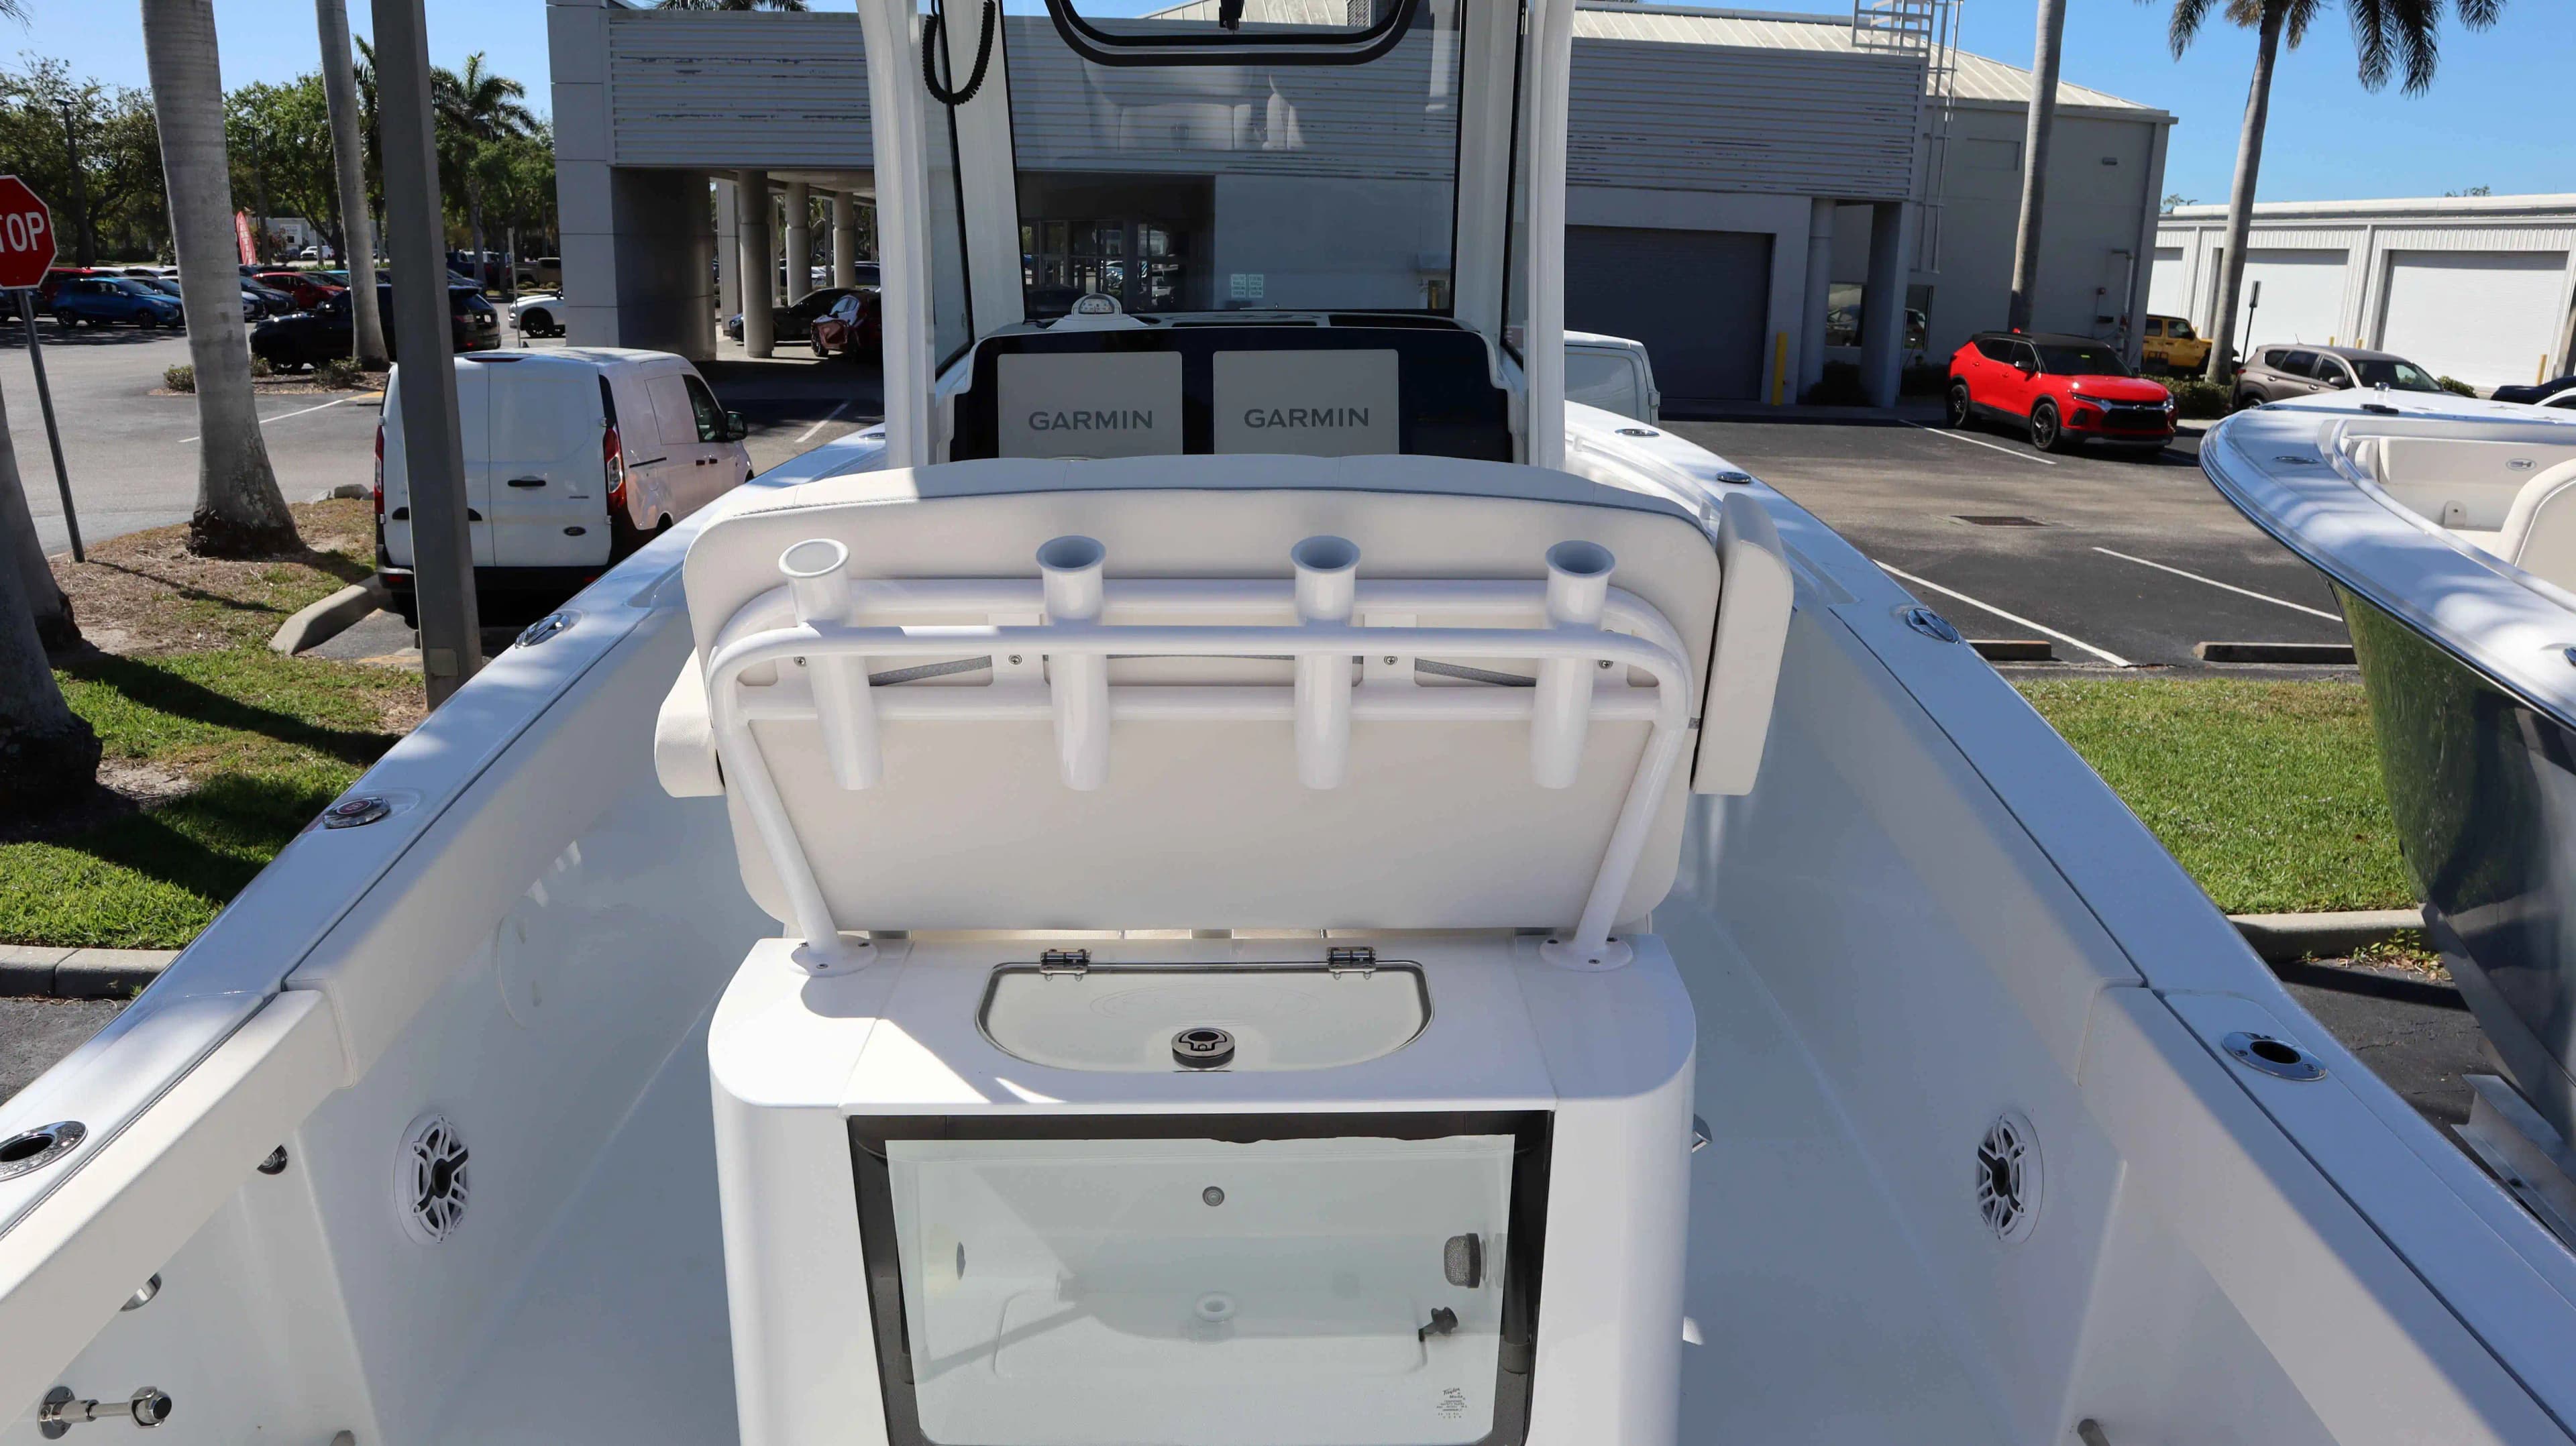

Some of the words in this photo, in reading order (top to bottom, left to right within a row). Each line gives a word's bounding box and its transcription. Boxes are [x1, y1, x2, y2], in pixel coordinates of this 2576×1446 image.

[0, 212, 44, 252] OP
[1028, 410, 1152, 431] GARMIN
[1244, 407, 1369, 428] GARMIN
